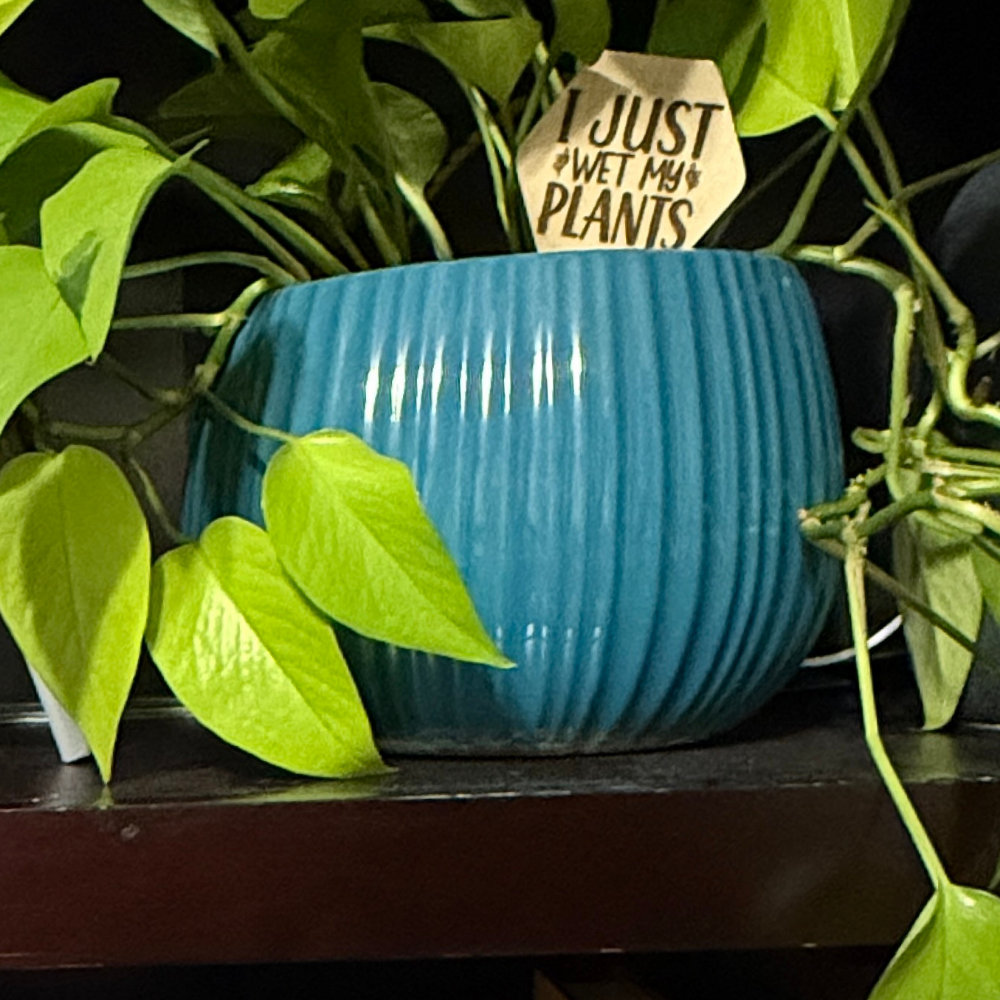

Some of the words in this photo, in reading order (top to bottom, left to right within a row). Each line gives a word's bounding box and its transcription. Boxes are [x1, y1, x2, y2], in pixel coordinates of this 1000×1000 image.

[558, 89, 581, 143] I
[589, 95, 724, 159] JUST
[573, 148, 635, 187] WET
[639, 156, 685, 193] MY
[537, 181, 693, 249] PLANTS
